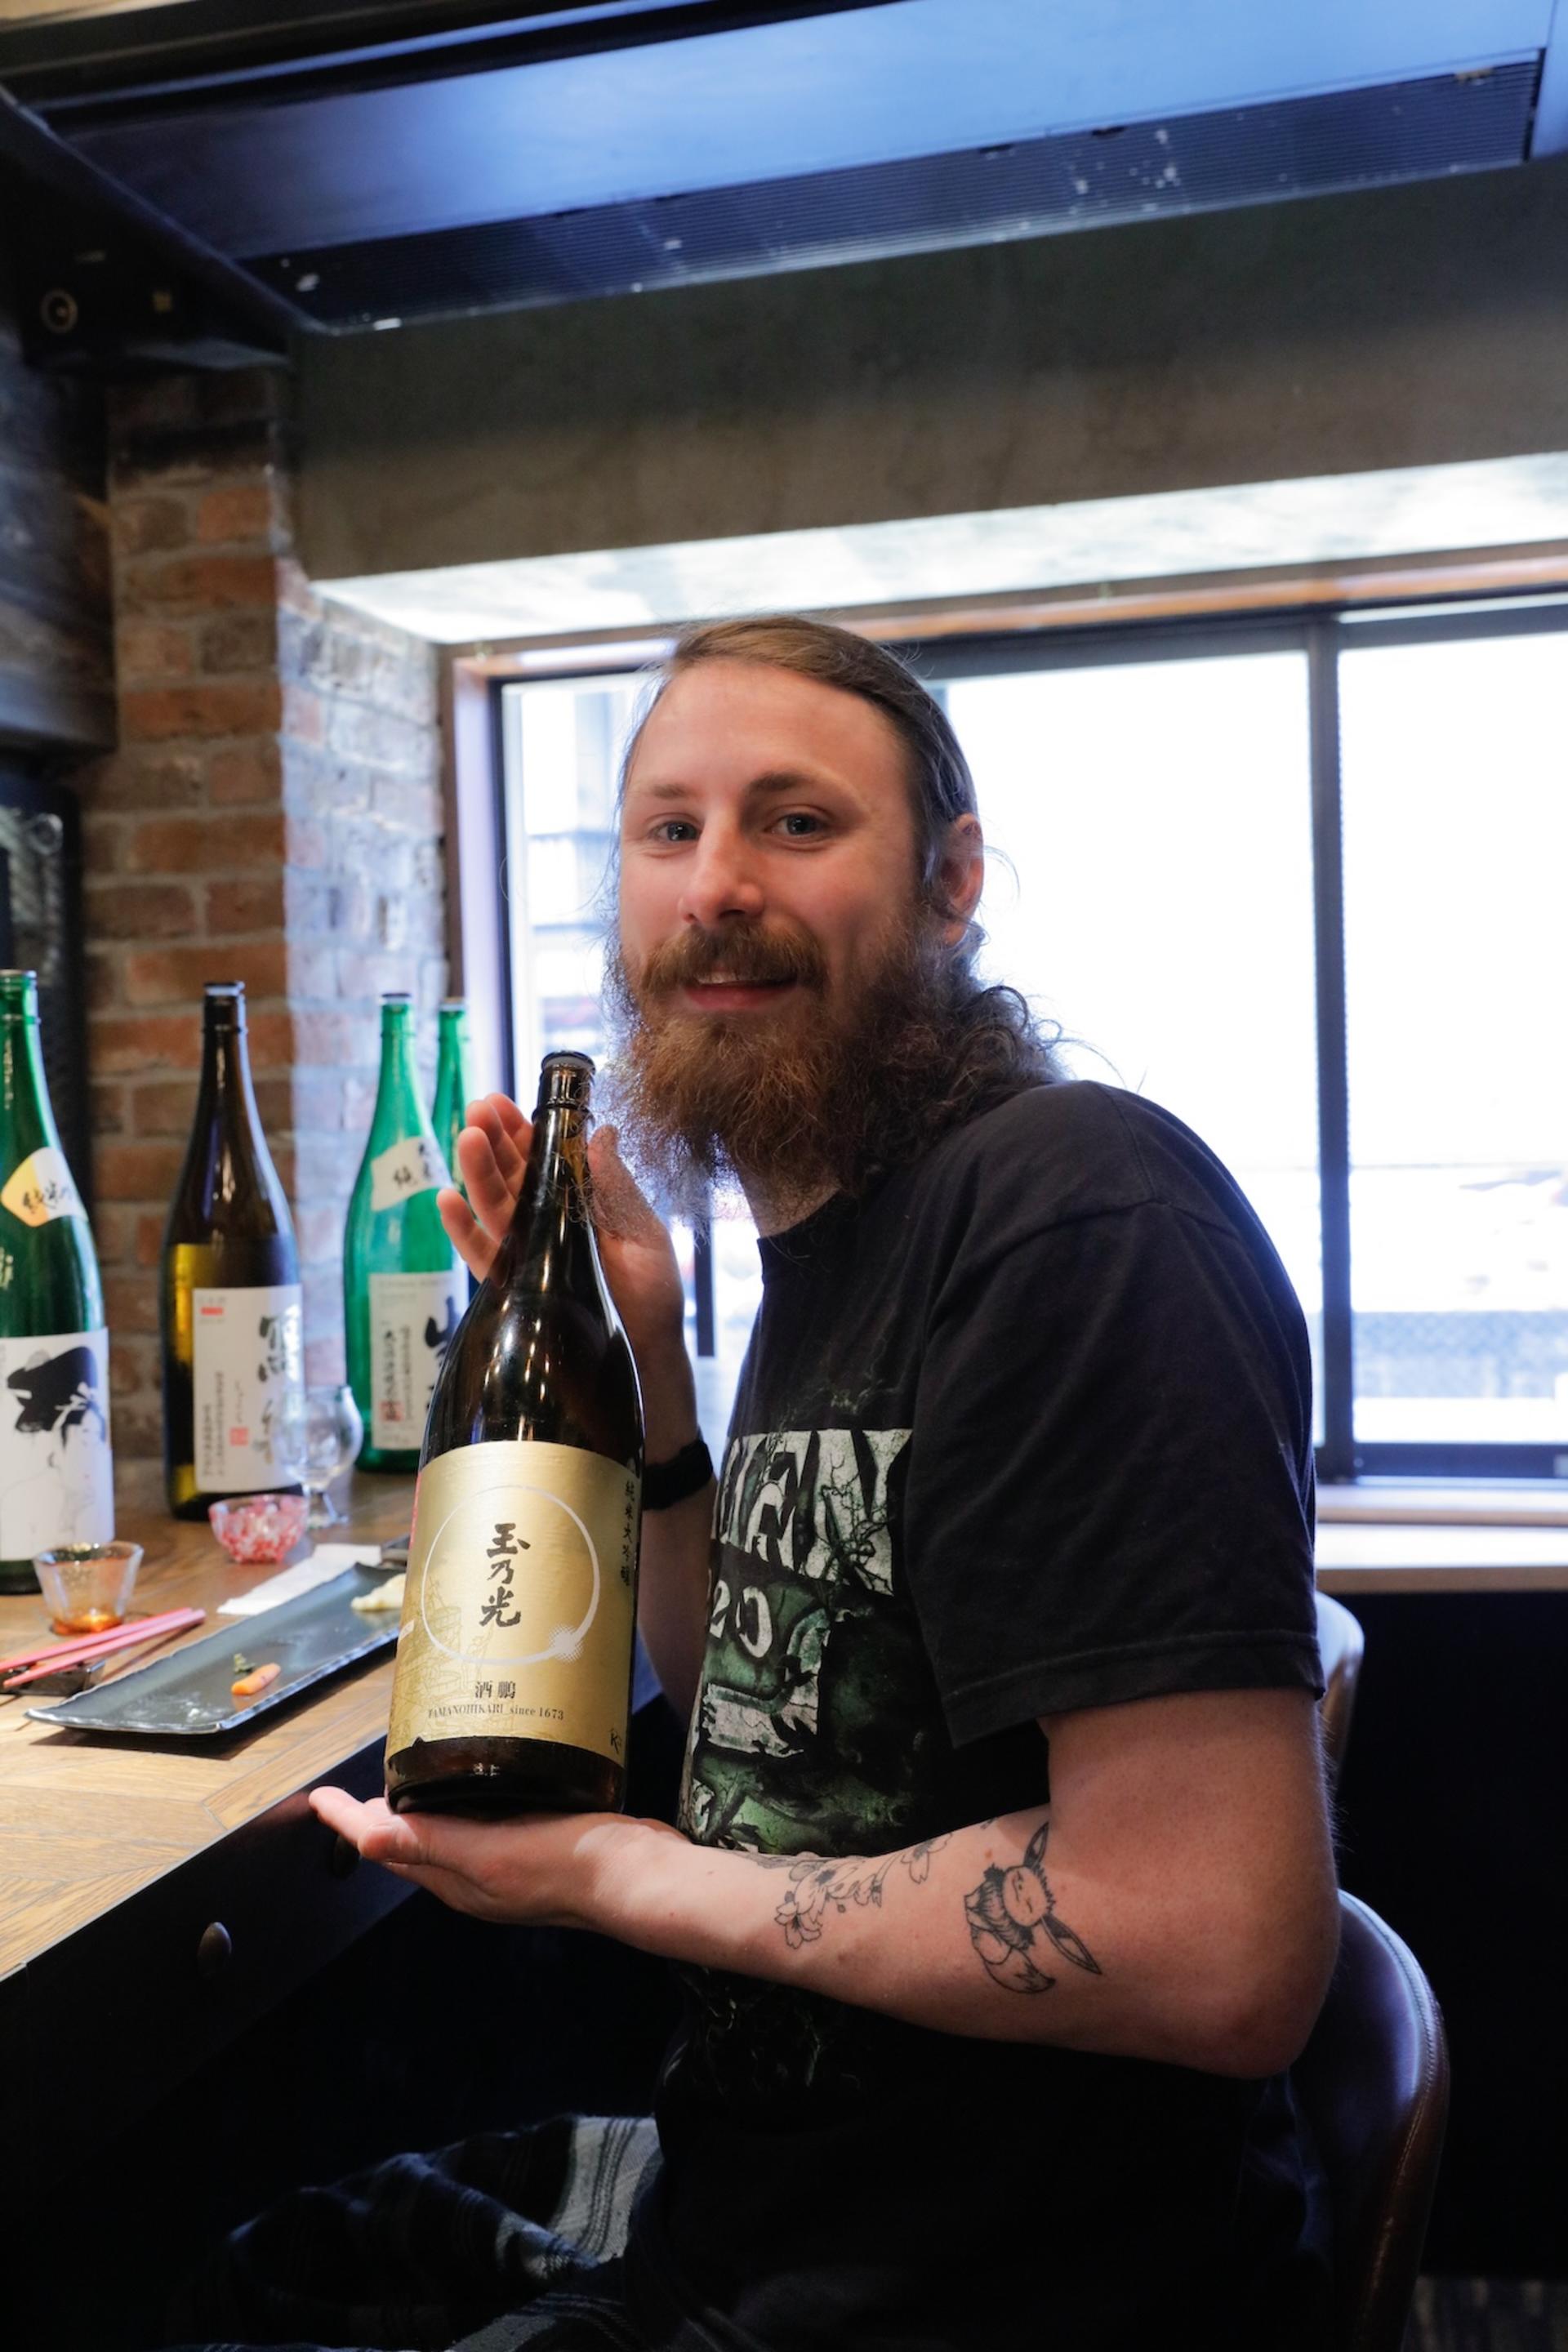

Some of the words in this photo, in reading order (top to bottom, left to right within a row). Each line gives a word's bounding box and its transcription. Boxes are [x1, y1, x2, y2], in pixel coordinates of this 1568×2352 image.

[479, 1522, 531, 1628] 玉乃光
[706, 1576, 773, 1659] 20
[509, 1704, 536, 1717] since
[538, 1708, 565, 1721] 1673
